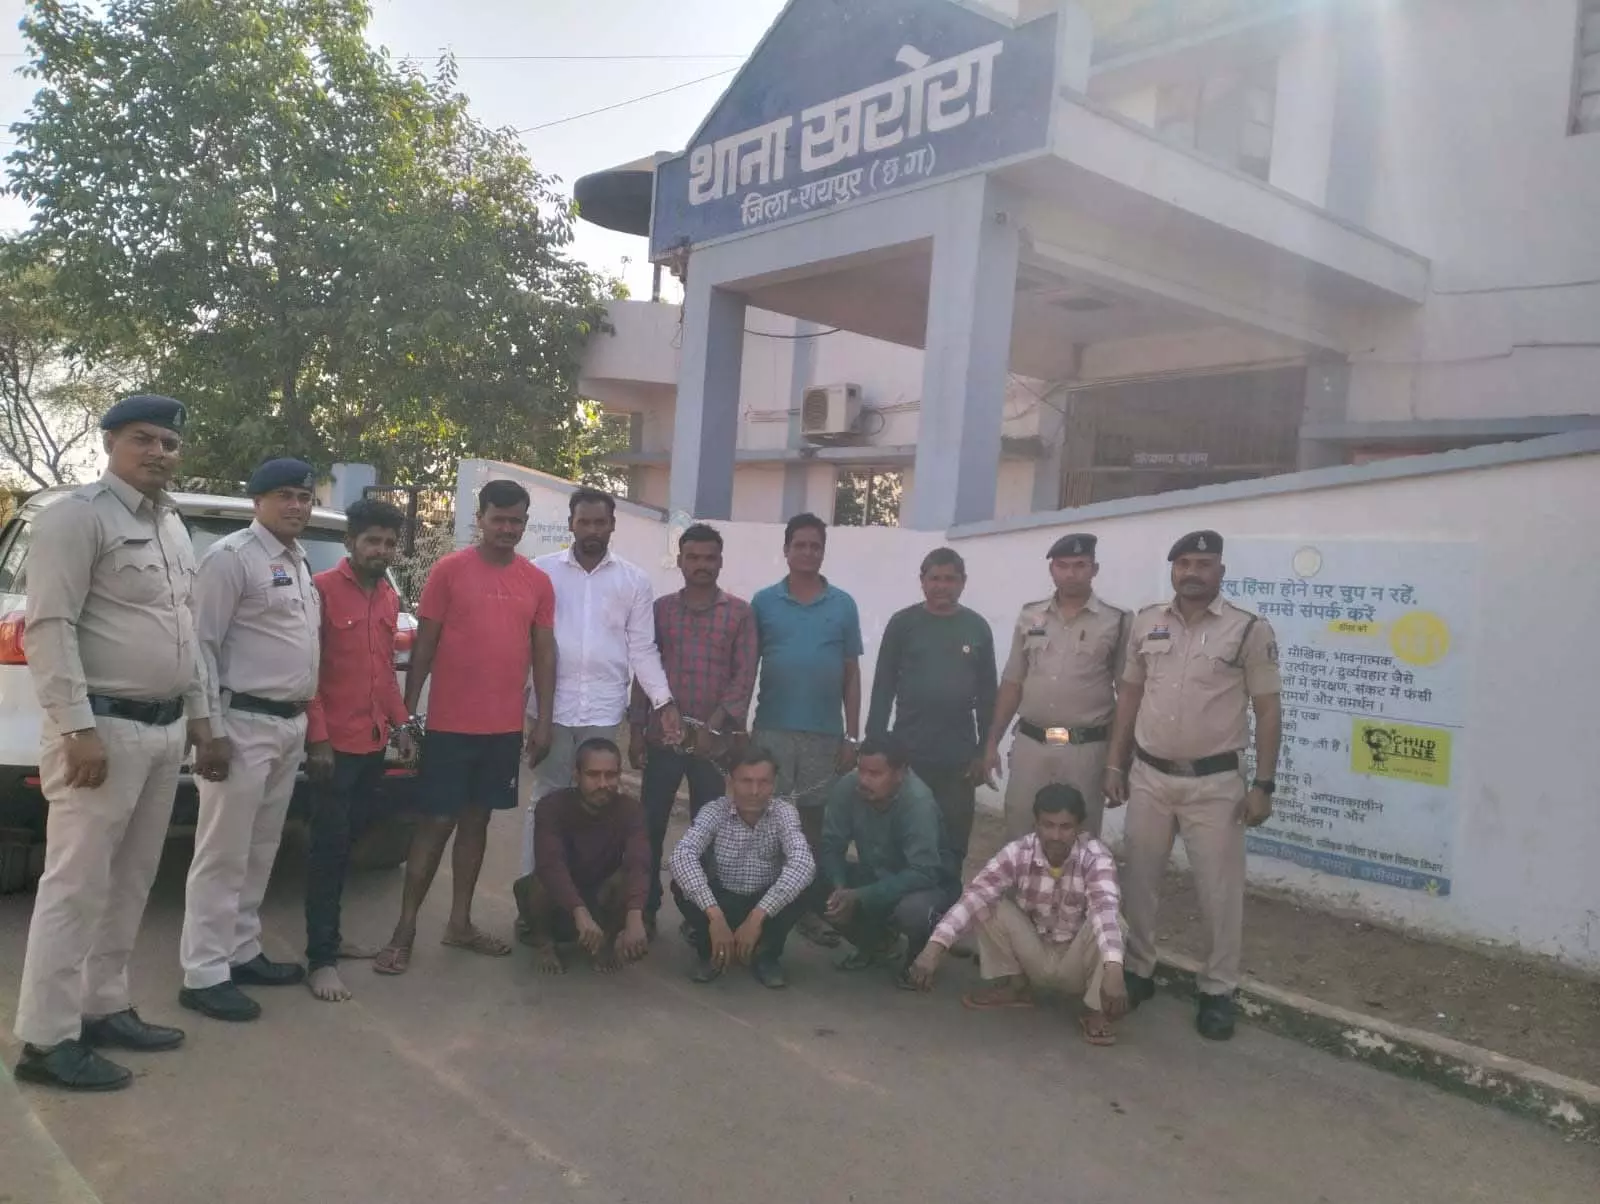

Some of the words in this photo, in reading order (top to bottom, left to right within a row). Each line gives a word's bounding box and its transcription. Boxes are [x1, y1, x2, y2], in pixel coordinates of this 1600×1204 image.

[688, 116, 793, 206] थाना
[800, 41, 1004, 172] खरोरा
[741, 168, 864, 226] जिला-रायपुर
[1243, 577, 1276, 596] हिंसा
[1280, 579, 1309, 598] होने
[1313, 583, 1336, 598] पर
[1339, 584, 1366, 603] चुप
[1371, 585, 1384, 601] न
[1257, 598, 1294, 616] हमसे
[1299, 599, 1342, 620] संपर्क
[1346, 604, 1377, 622] करें
[1391, 669, 1414, 685] जैसे
[1354, 682, 1386, 697] संकट
[1389, 684, 1401, 699] में
[1312, 691, 1333, 705] और
[1337, 696, 1375, 712] समर्थन
[1393, 735, 1436, 750] CHILD
[1394, 744, 1435, 759] LINE
